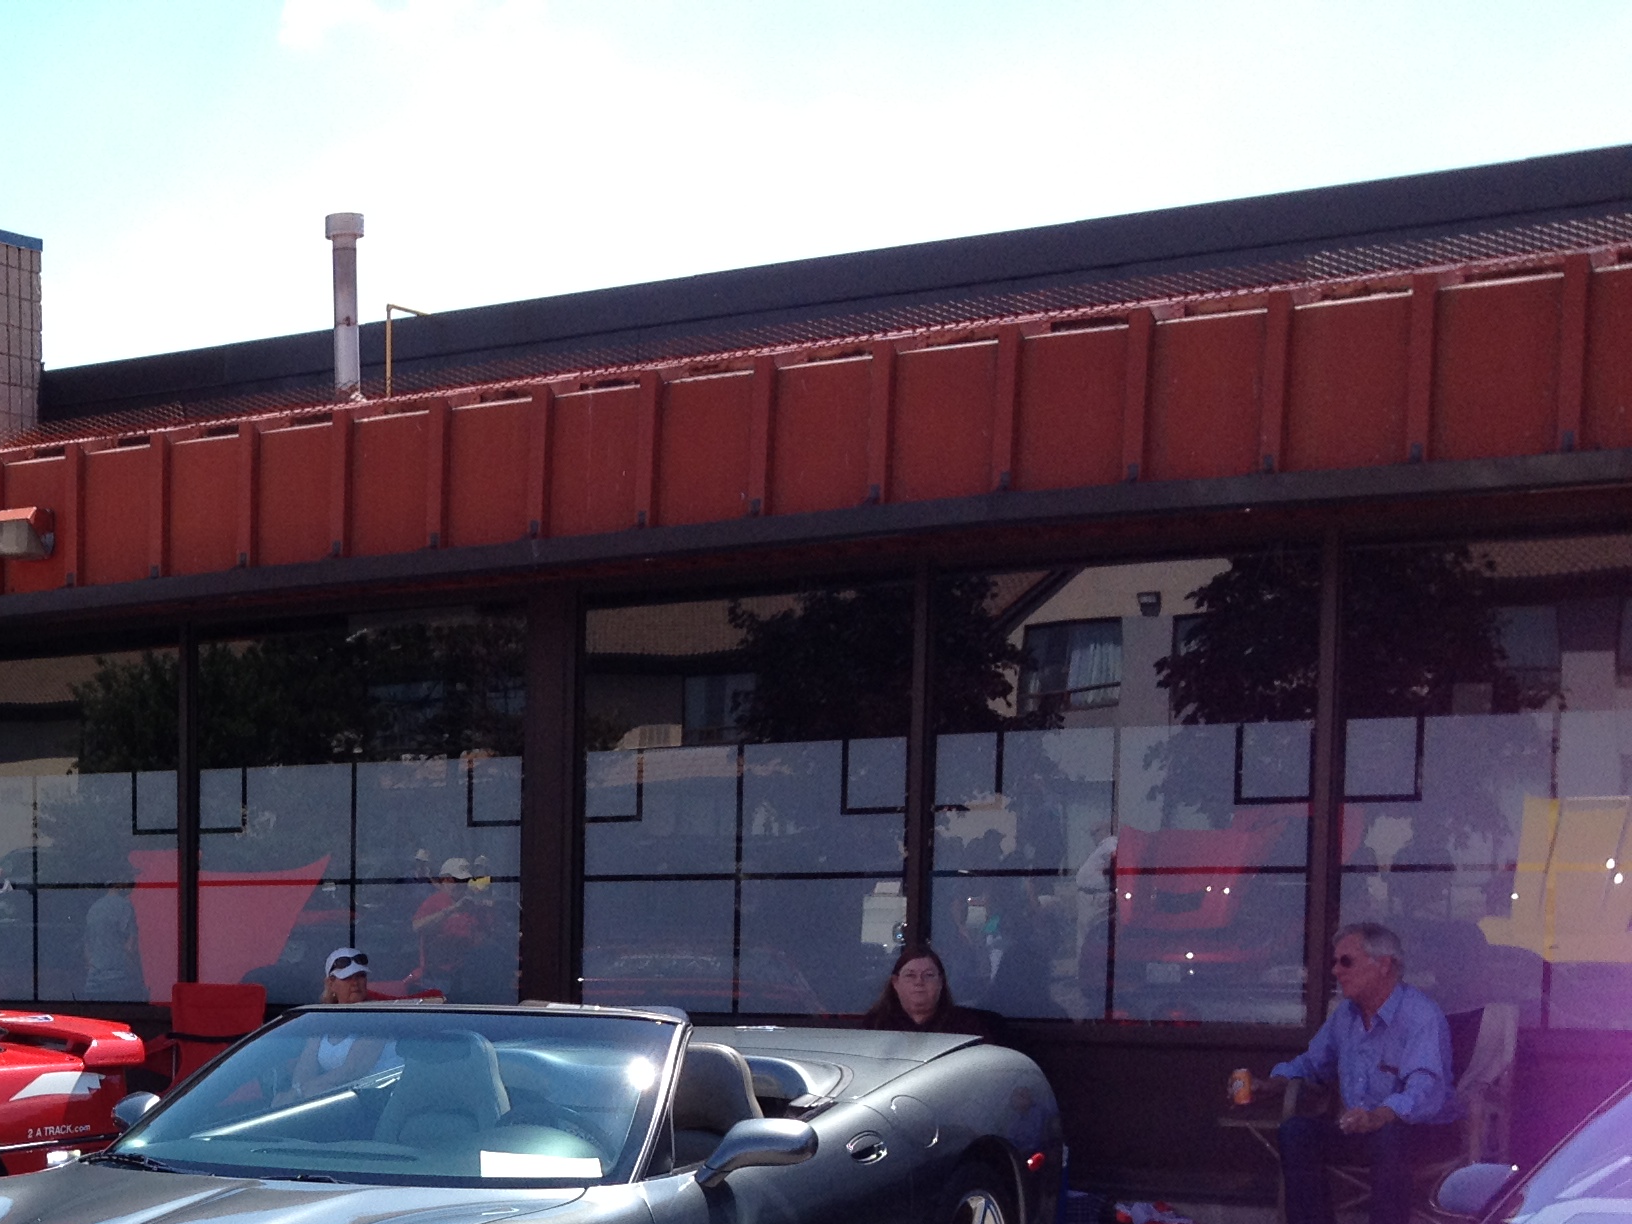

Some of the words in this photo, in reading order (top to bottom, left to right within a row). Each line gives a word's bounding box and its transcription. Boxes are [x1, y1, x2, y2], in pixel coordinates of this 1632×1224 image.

[28, 1128, 33, 1138] 2
[36, 1128, 42, 1137] A
[44, 1124, 91, 1136] TRACK.com
